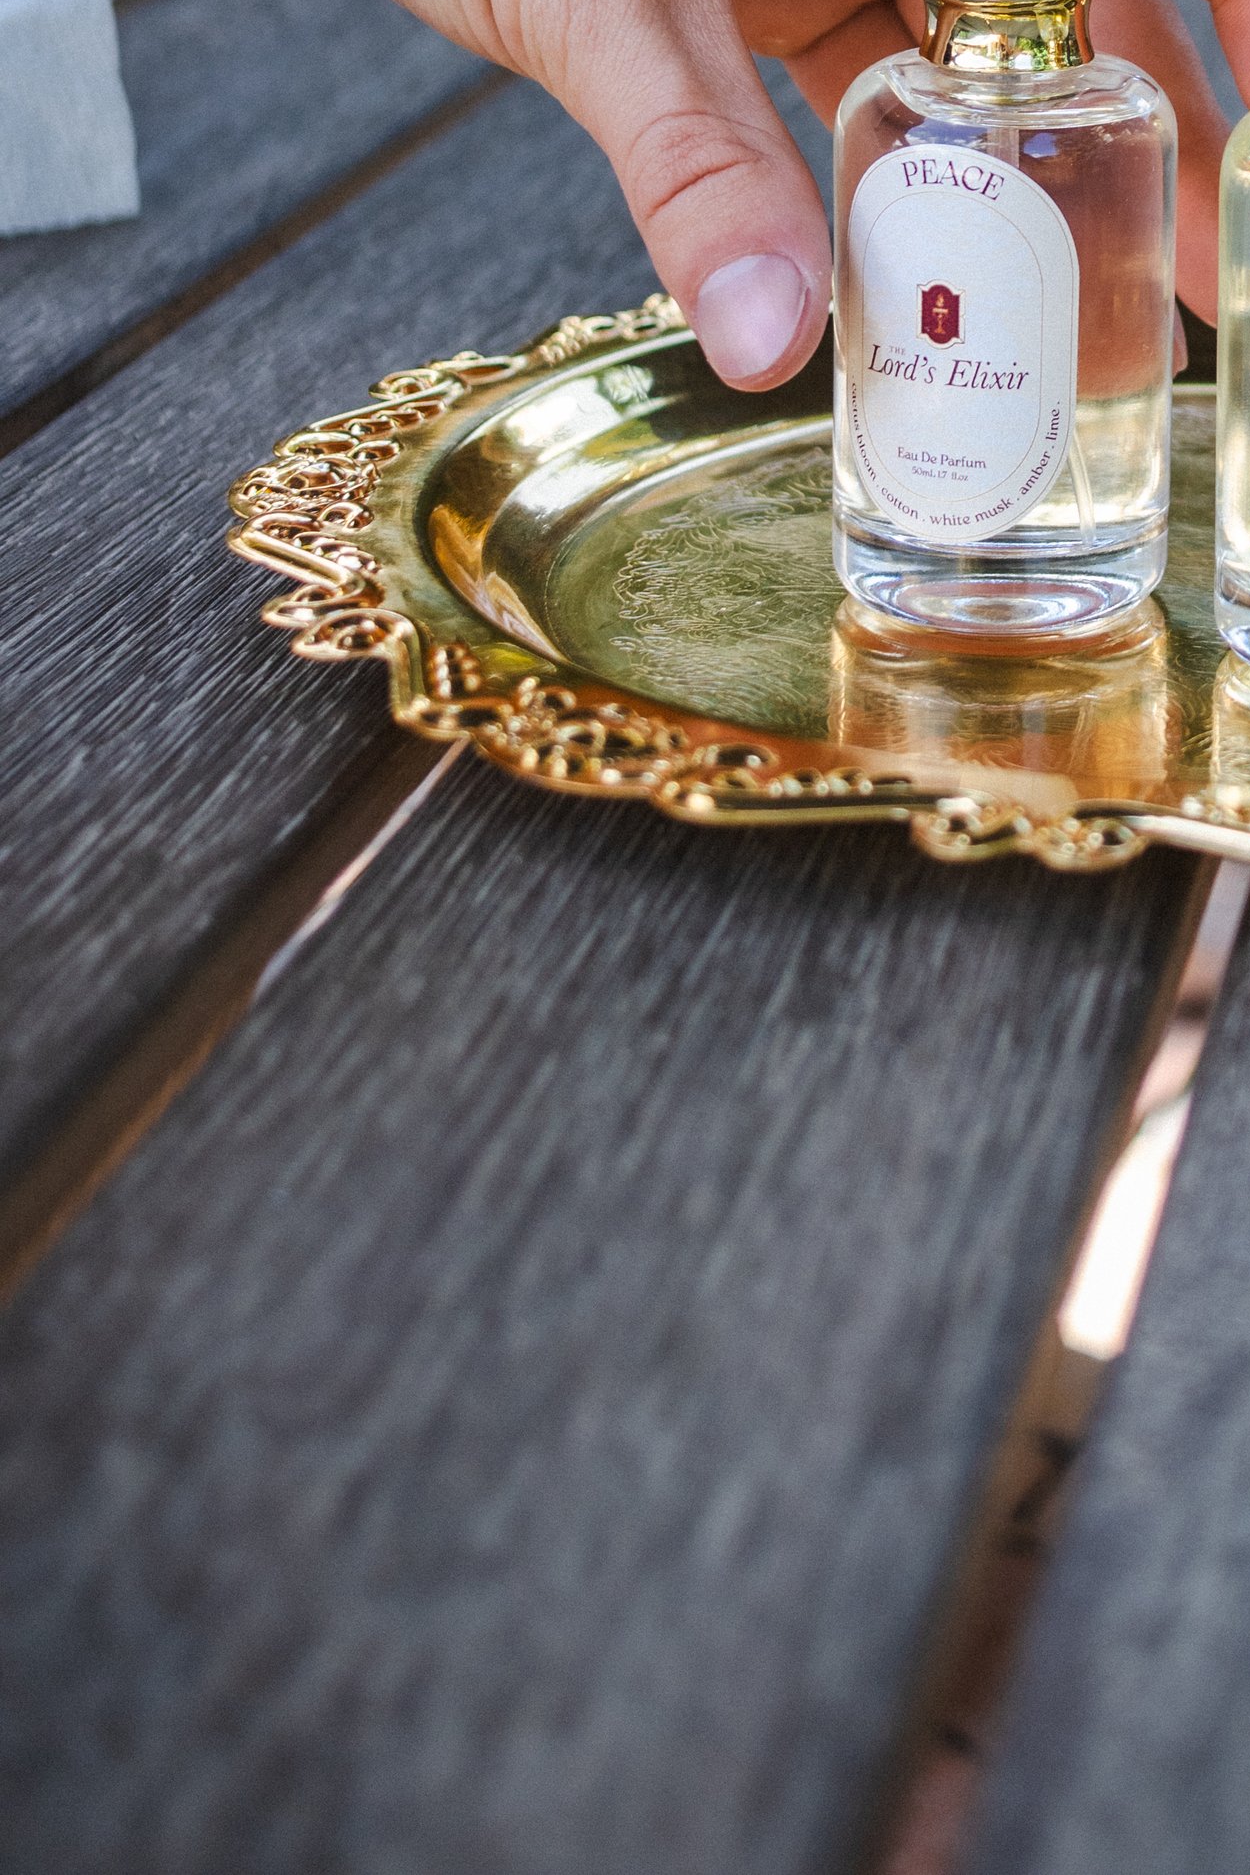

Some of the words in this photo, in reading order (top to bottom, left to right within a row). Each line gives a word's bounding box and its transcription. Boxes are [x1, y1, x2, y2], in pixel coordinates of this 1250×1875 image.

[901, 158, 1005, 201] PEACE
[945, 358, 1030, 390] Elixir
[857, 434, 877, 482] bloom
[881, 486, 919, 520] cotton
[929, 513, 971, 526] white
[974, 498, 1015, 523] musk
[1019, 451, 1051, 495] amber
[1045, 408, 1060, 441] lime
[897, 446, 918, 461] Eau
[921, 451, 937, 465] De
[940, 453, 987, 469] Parfum
